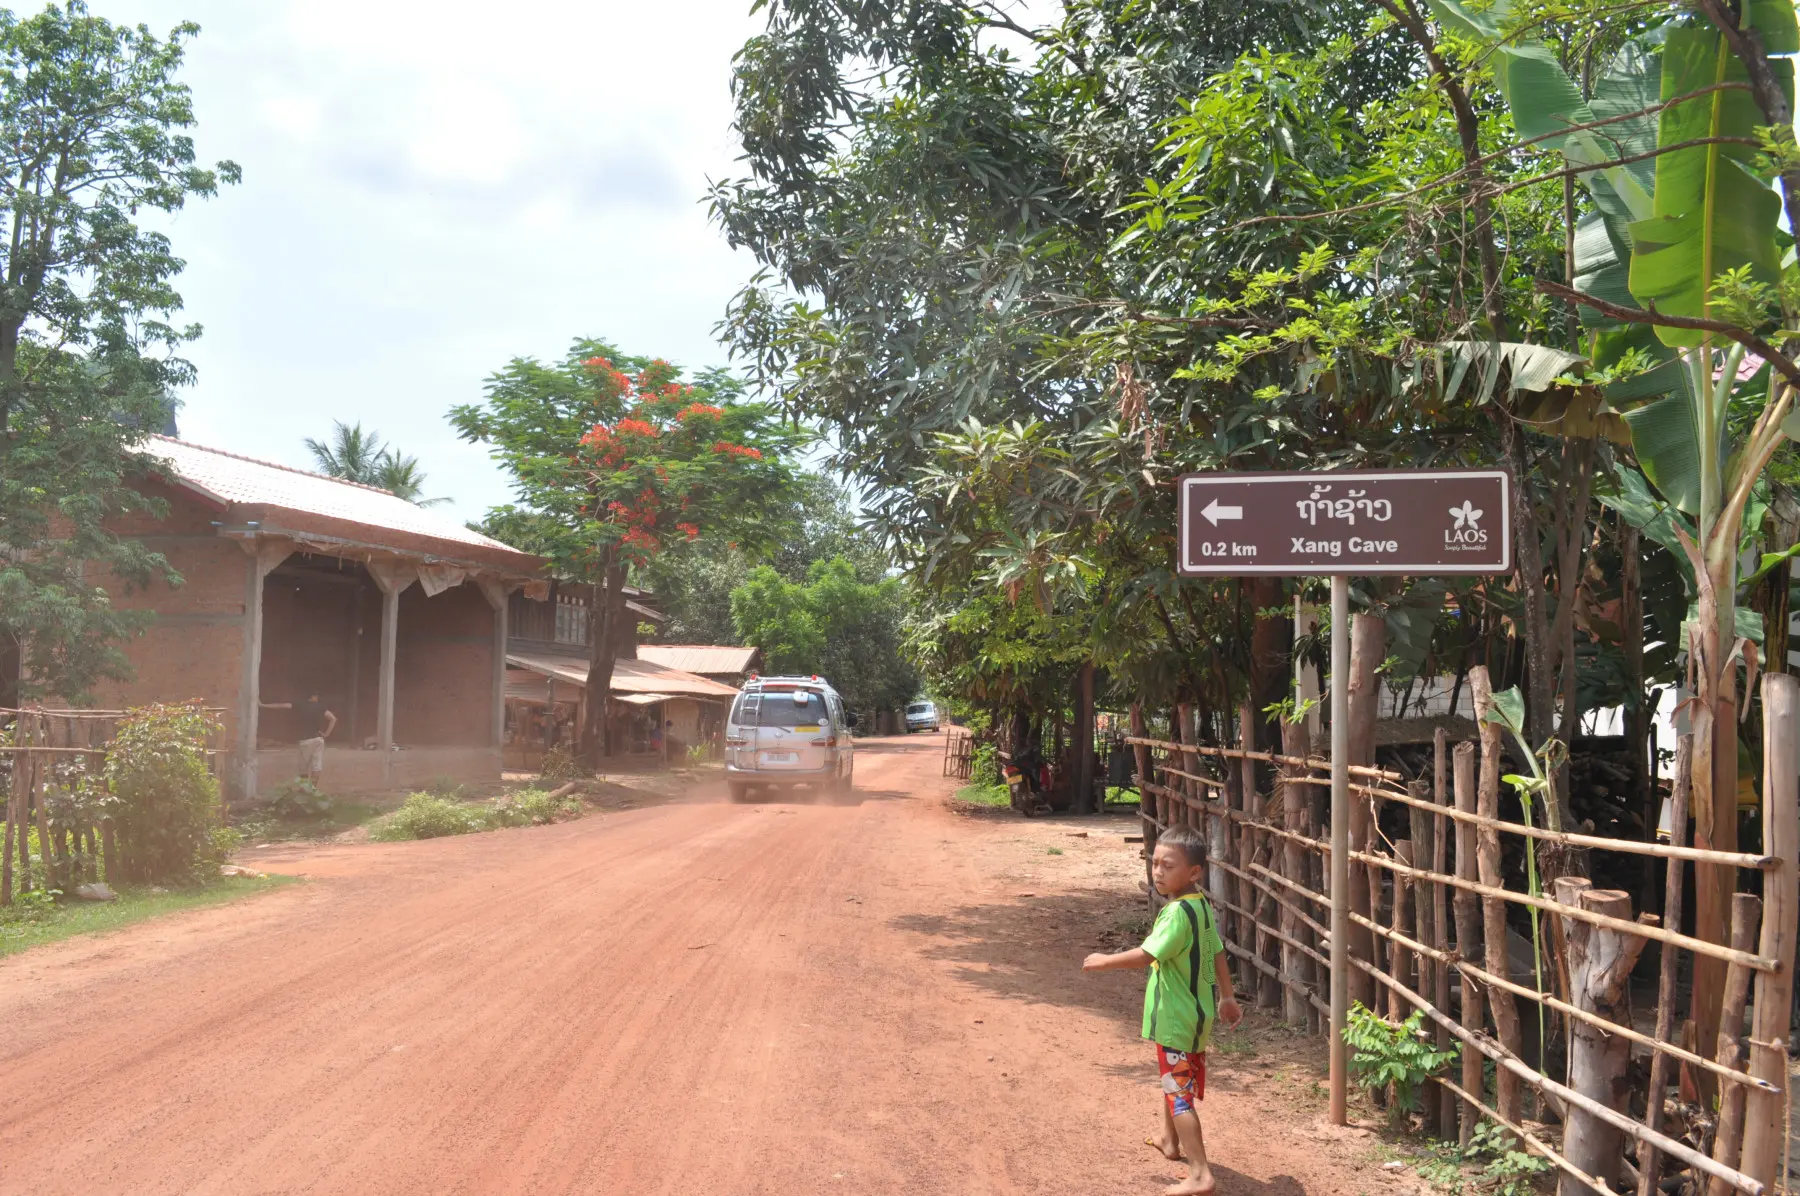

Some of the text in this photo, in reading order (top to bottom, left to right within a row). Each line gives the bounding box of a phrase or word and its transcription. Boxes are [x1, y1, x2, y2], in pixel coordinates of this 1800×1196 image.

[1444, 529, 1488, 543] LAOS
[1201, 541, 1257, 557] 0.2 km
[1290, 536, 1399, 557] Xang Cave
